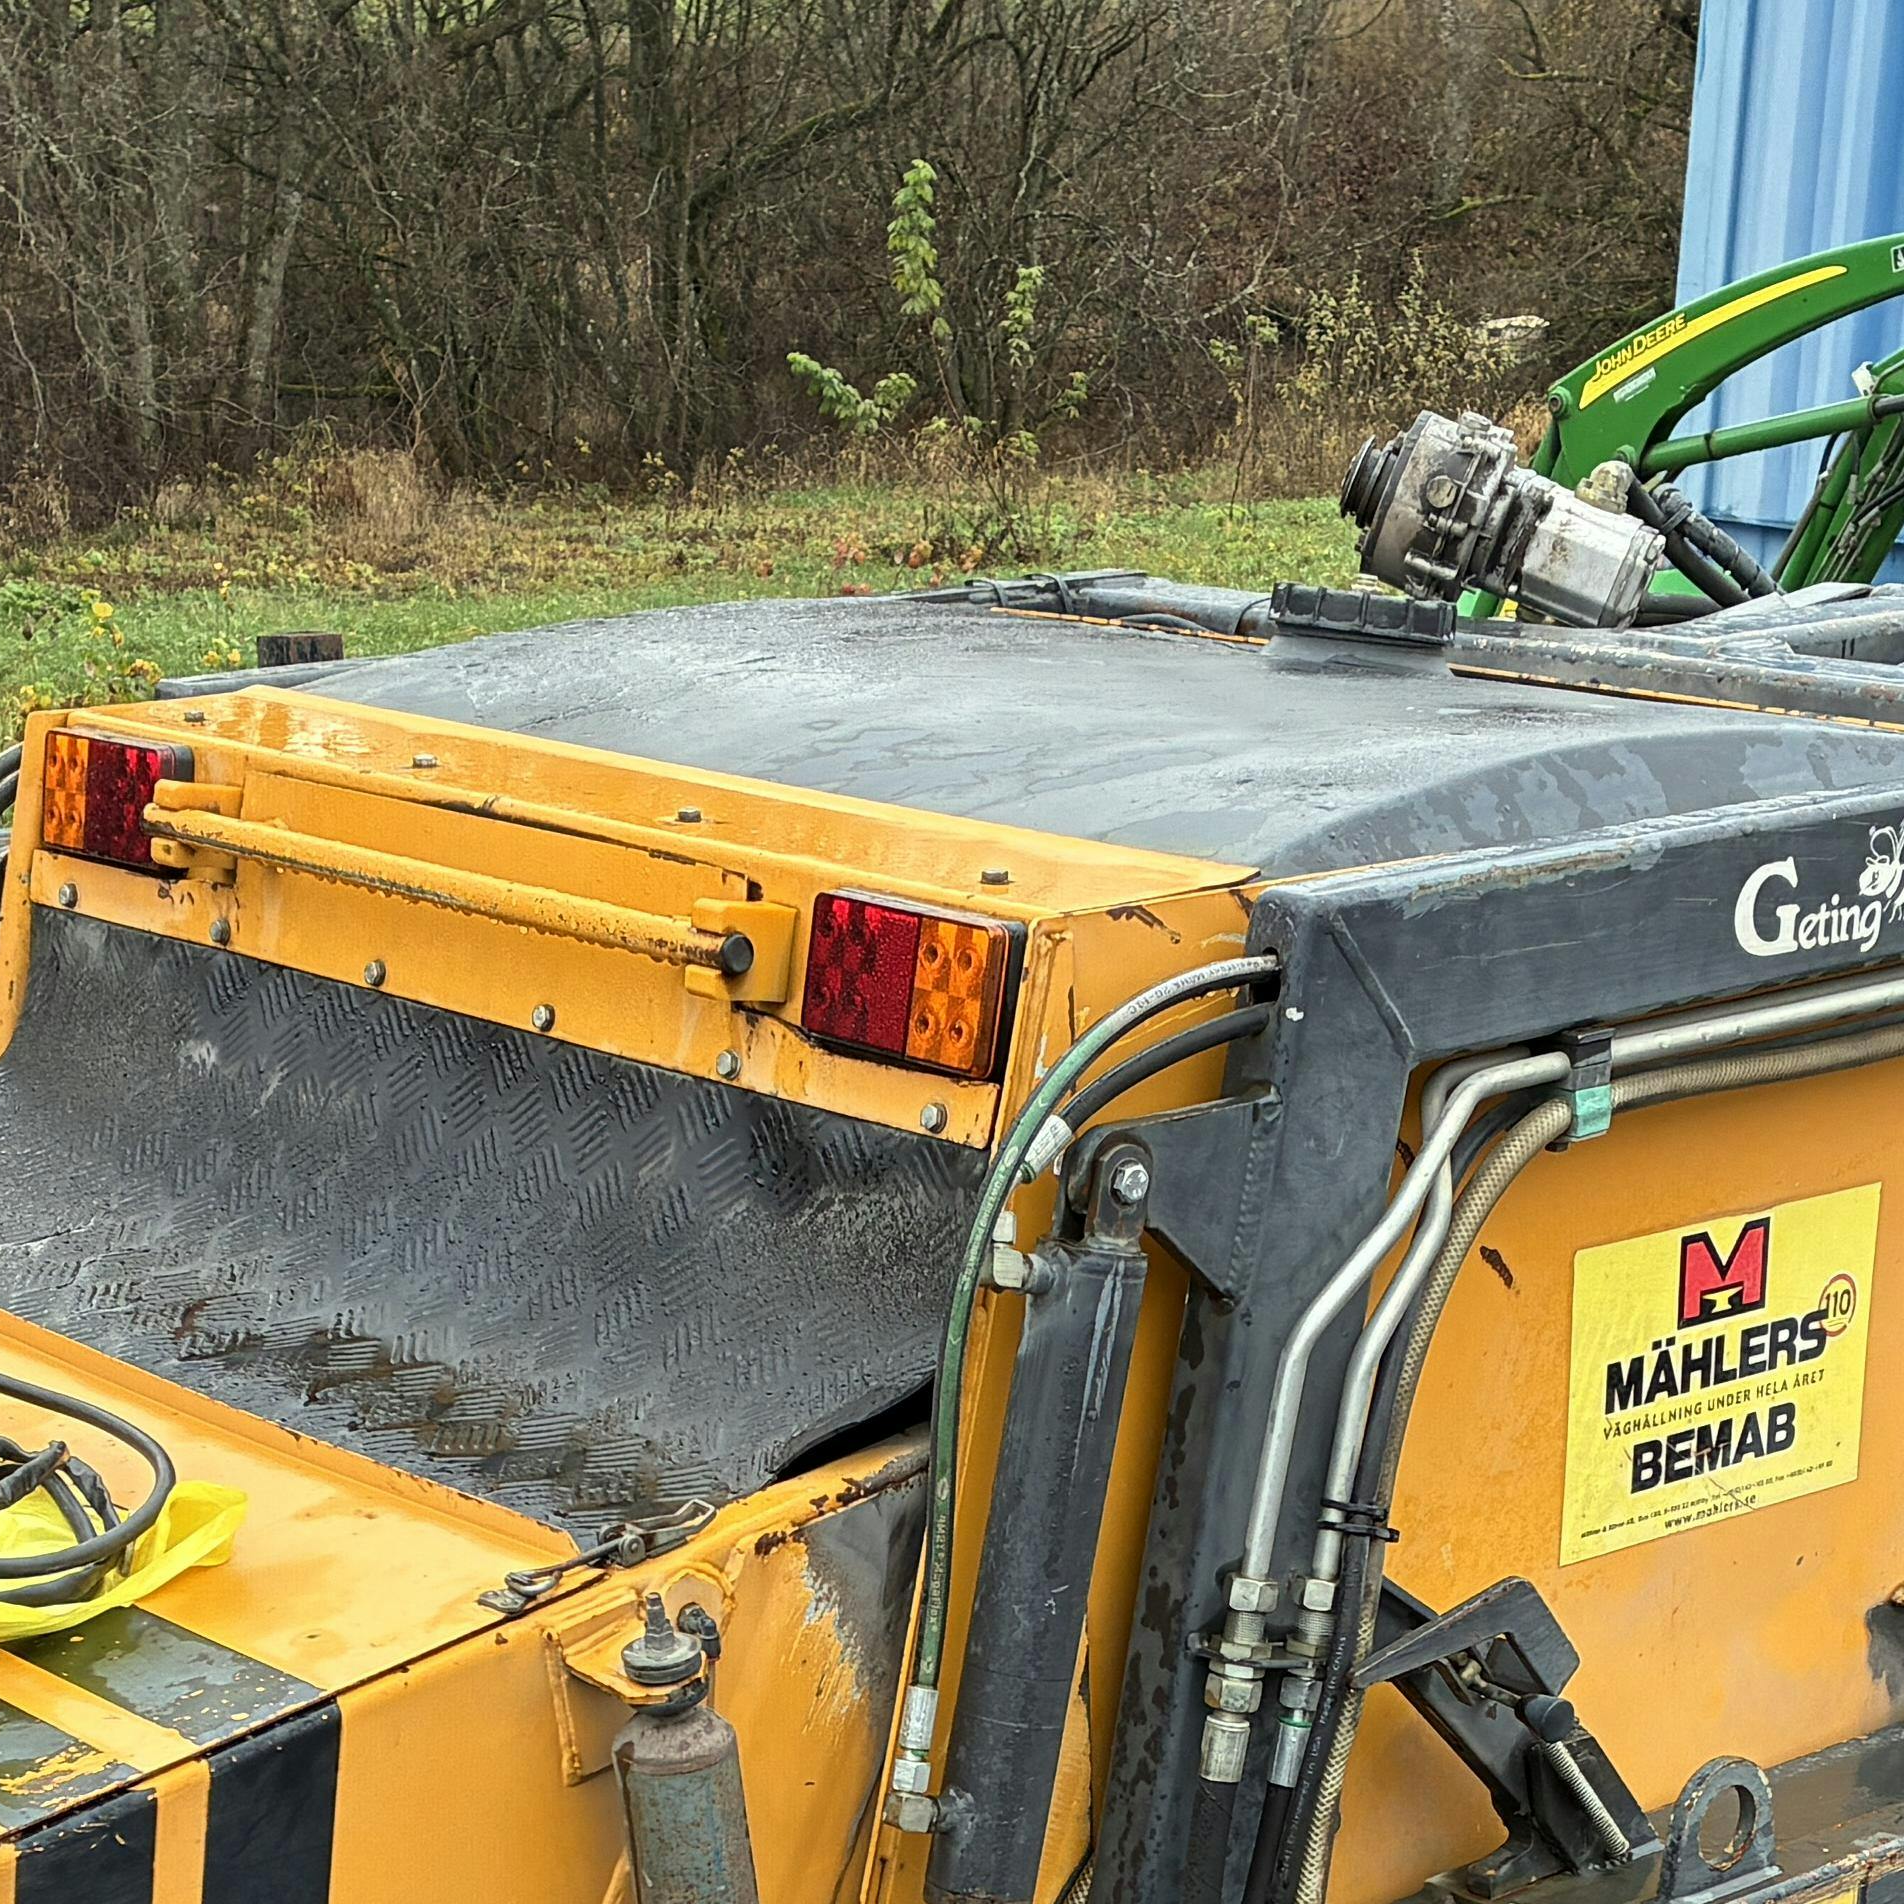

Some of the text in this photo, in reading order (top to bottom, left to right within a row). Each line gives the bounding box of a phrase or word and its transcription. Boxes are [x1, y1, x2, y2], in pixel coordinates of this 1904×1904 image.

[1592, 313, 1686, 382] JOHN DEERE
[1734, 855, 1882, 956] Geting
[1825, 1288, 1852, 1318] 110
[1602, 1367, 1826, 1440] VÄGHÅLLNING UNDER HELA ÅRET
[1604, 1309, 1829, 1415] MÄHLERS
[1630, 1401, 1796, 1494] BEMAB
